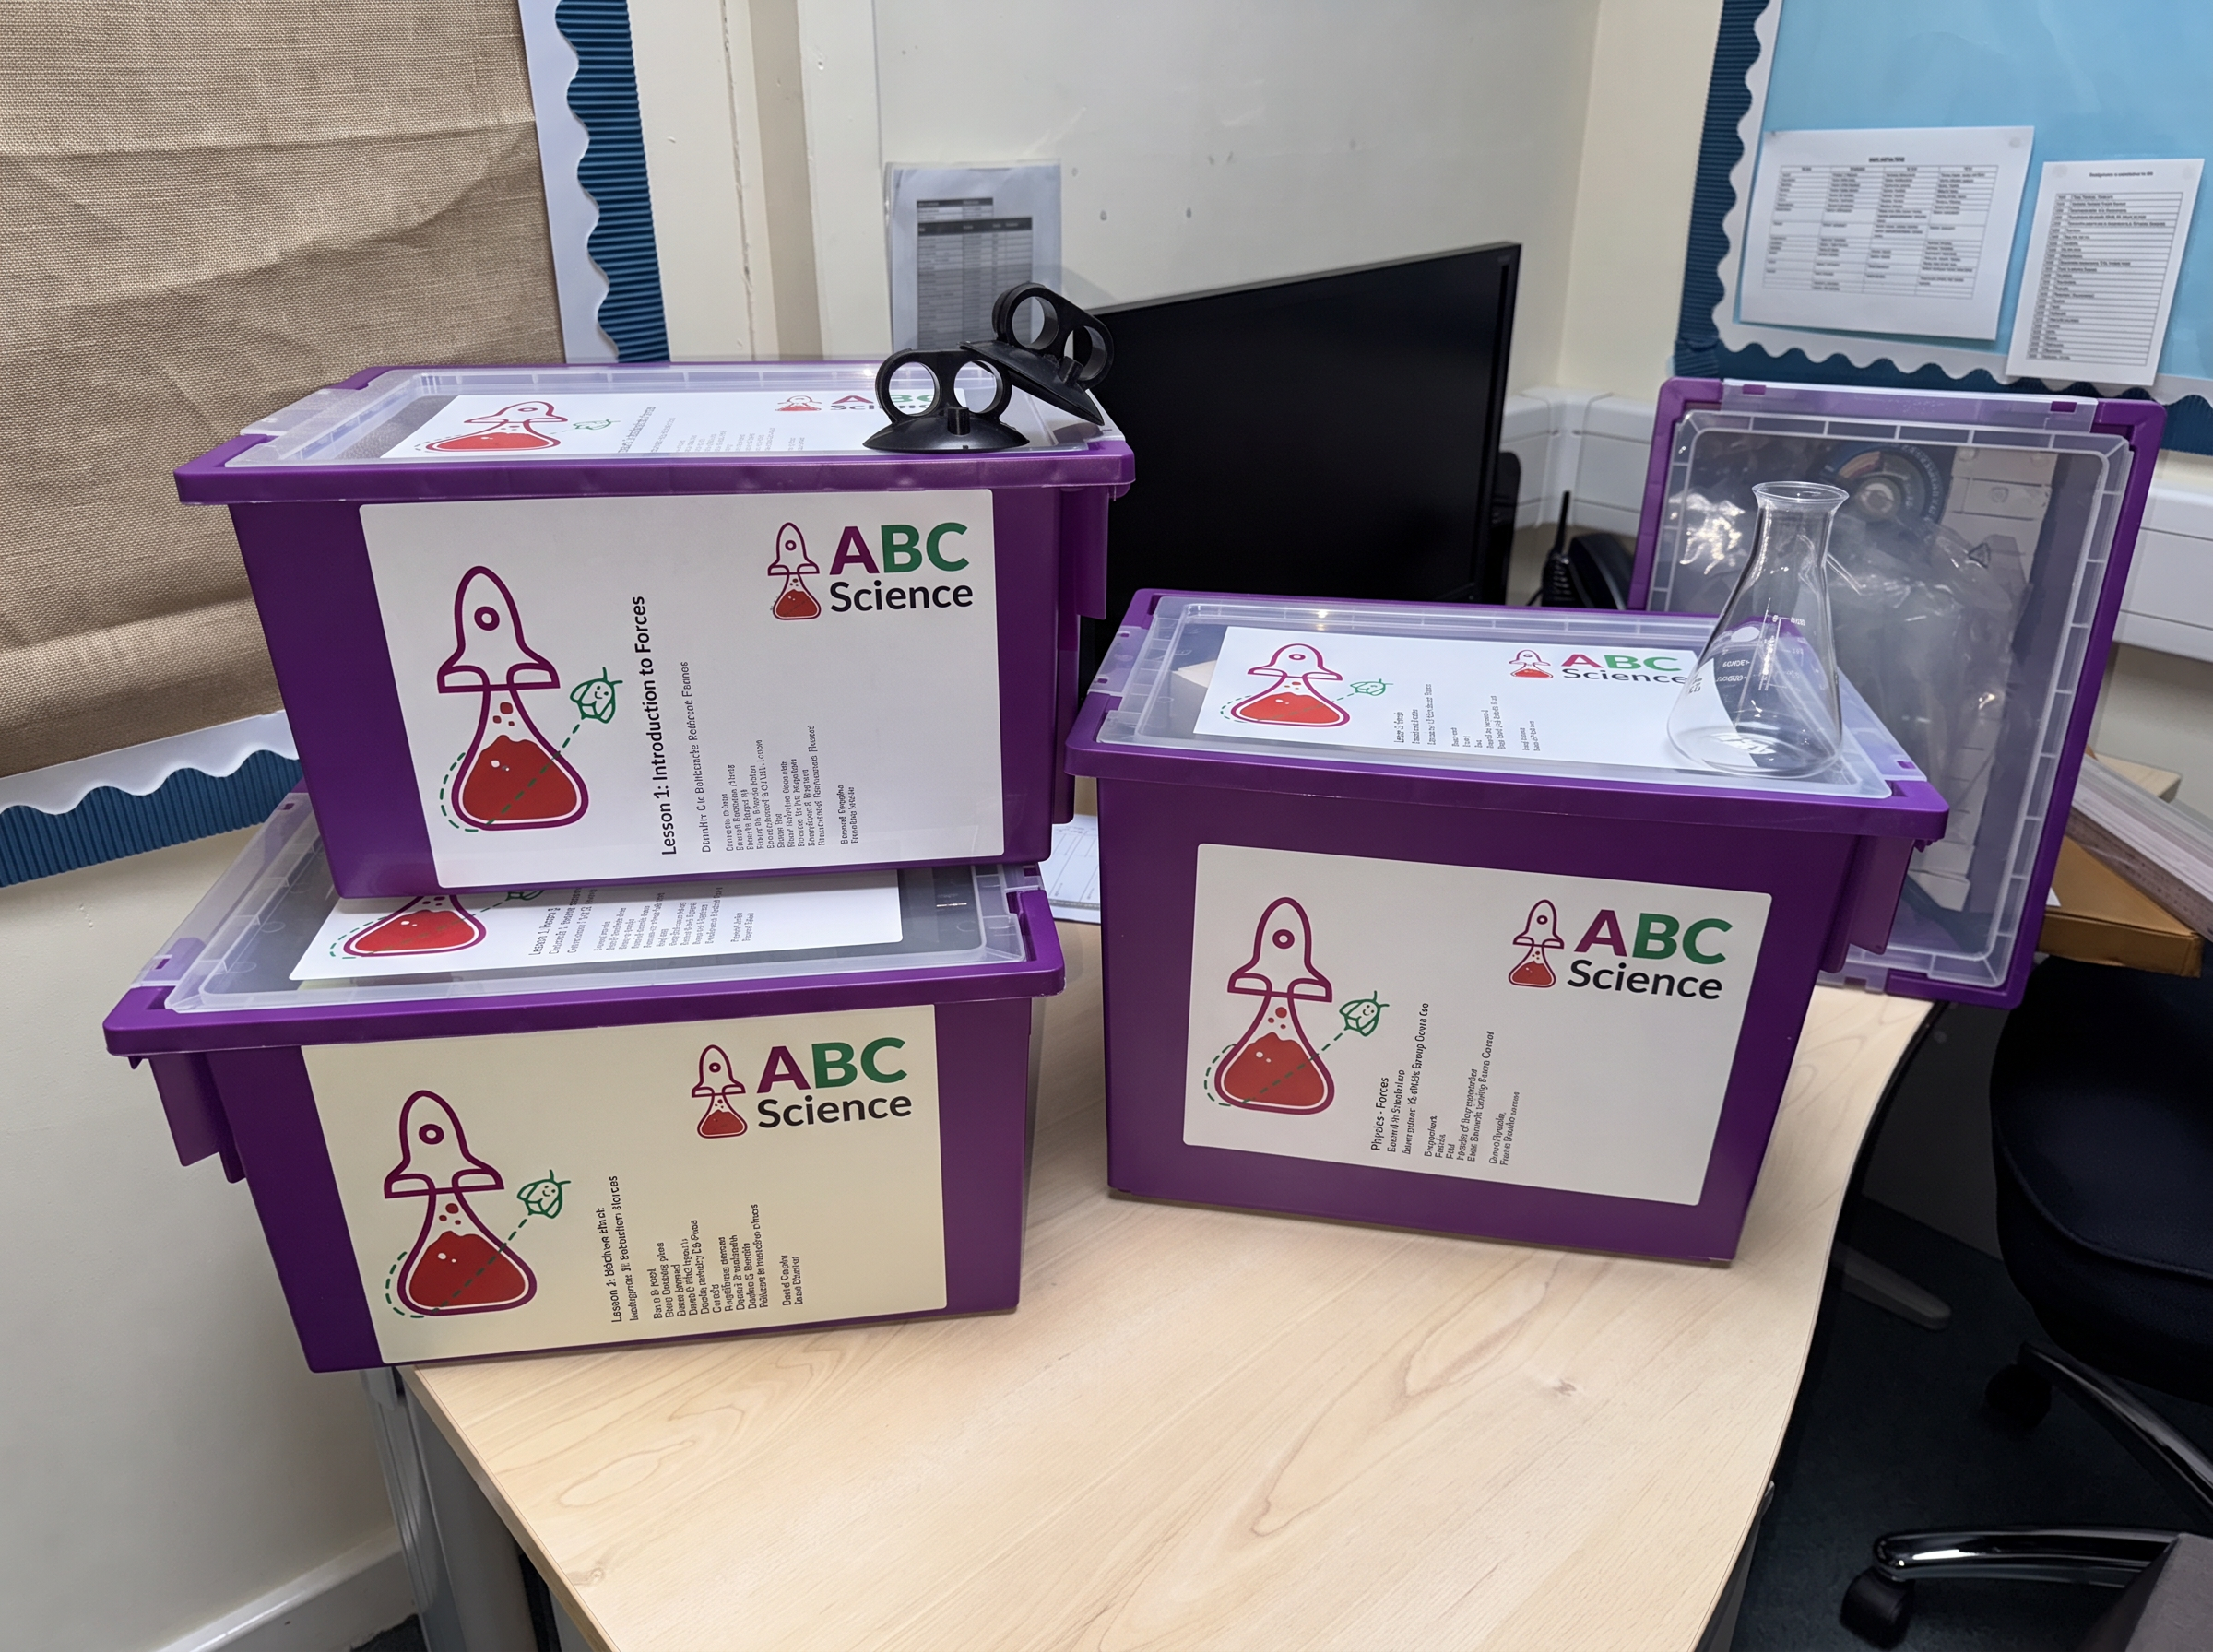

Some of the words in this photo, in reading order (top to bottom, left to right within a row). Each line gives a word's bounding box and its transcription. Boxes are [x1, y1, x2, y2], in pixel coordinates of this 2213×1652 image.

[829, 522, 969, 575] ABC
[830, 580, 973, 612] Science
[632, 596, 651, 653] Forces
[638, 657, 654, 677] to
[1561, 654, 1682, 672] ABC
[1562, 668, 1687, 684] Science
[643, 679, 668, 781] Introduction
[653, 785, 669, 799] 1:
[661, 803, 677, 855] Lesson
[1574, 909, 1734, 964] ABC
[1567, 959, 1722, 999] Science
[756, 1037, 908, 1094] ABC
[1376, 1077, 1389, 1109] Forces
[757, 1095, 912, 1128] Science
